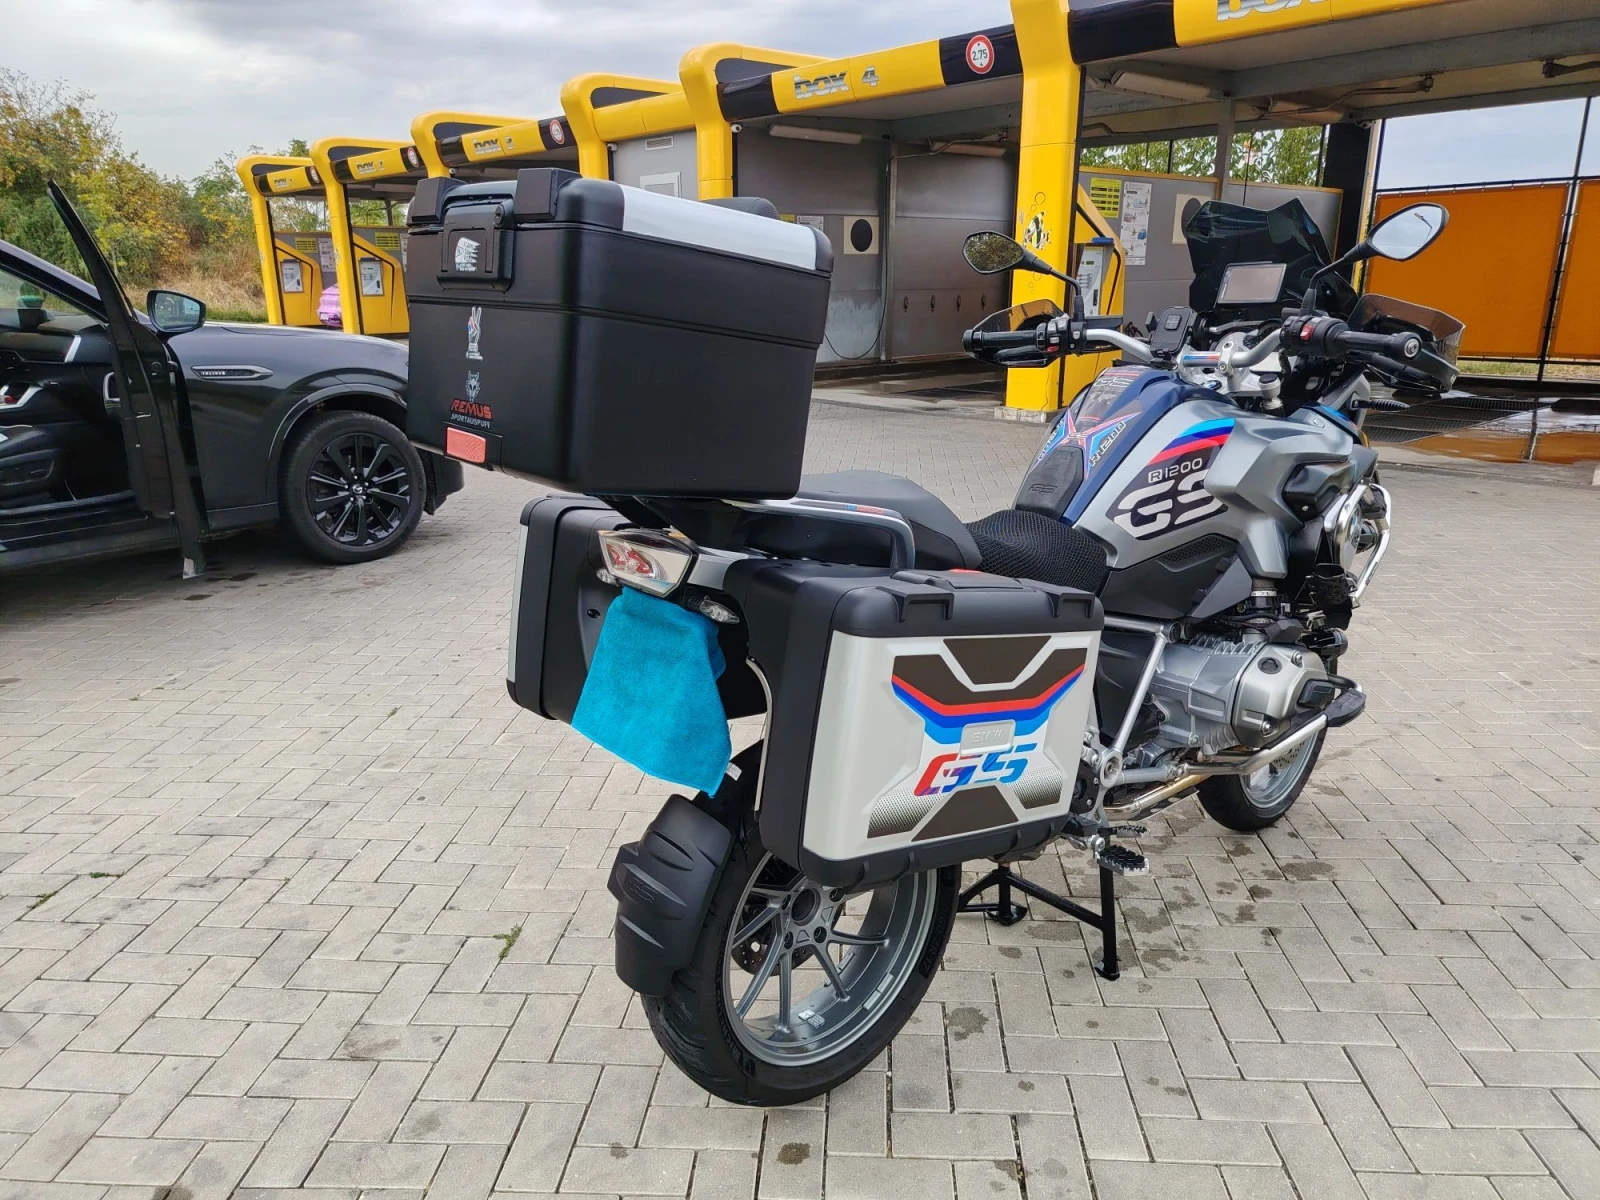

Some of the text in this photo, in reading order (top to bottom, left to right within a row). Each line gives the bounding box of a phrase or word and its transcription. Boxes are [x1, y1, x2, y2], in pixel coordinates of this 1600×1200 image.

[971, 48, 988, 61] 2.75
[793, 65, 880, 99] box 4
[450, 398, 493, 420] REMUS
[450, 412, 491, 429] SPORTAUSPUFF
[1088, 420, 1127, 468] R1200
[1147, 457, 1203, 484] R1200
[1113, 468, 1224, 541] GS
[913, 742, 1038, 797] GS
